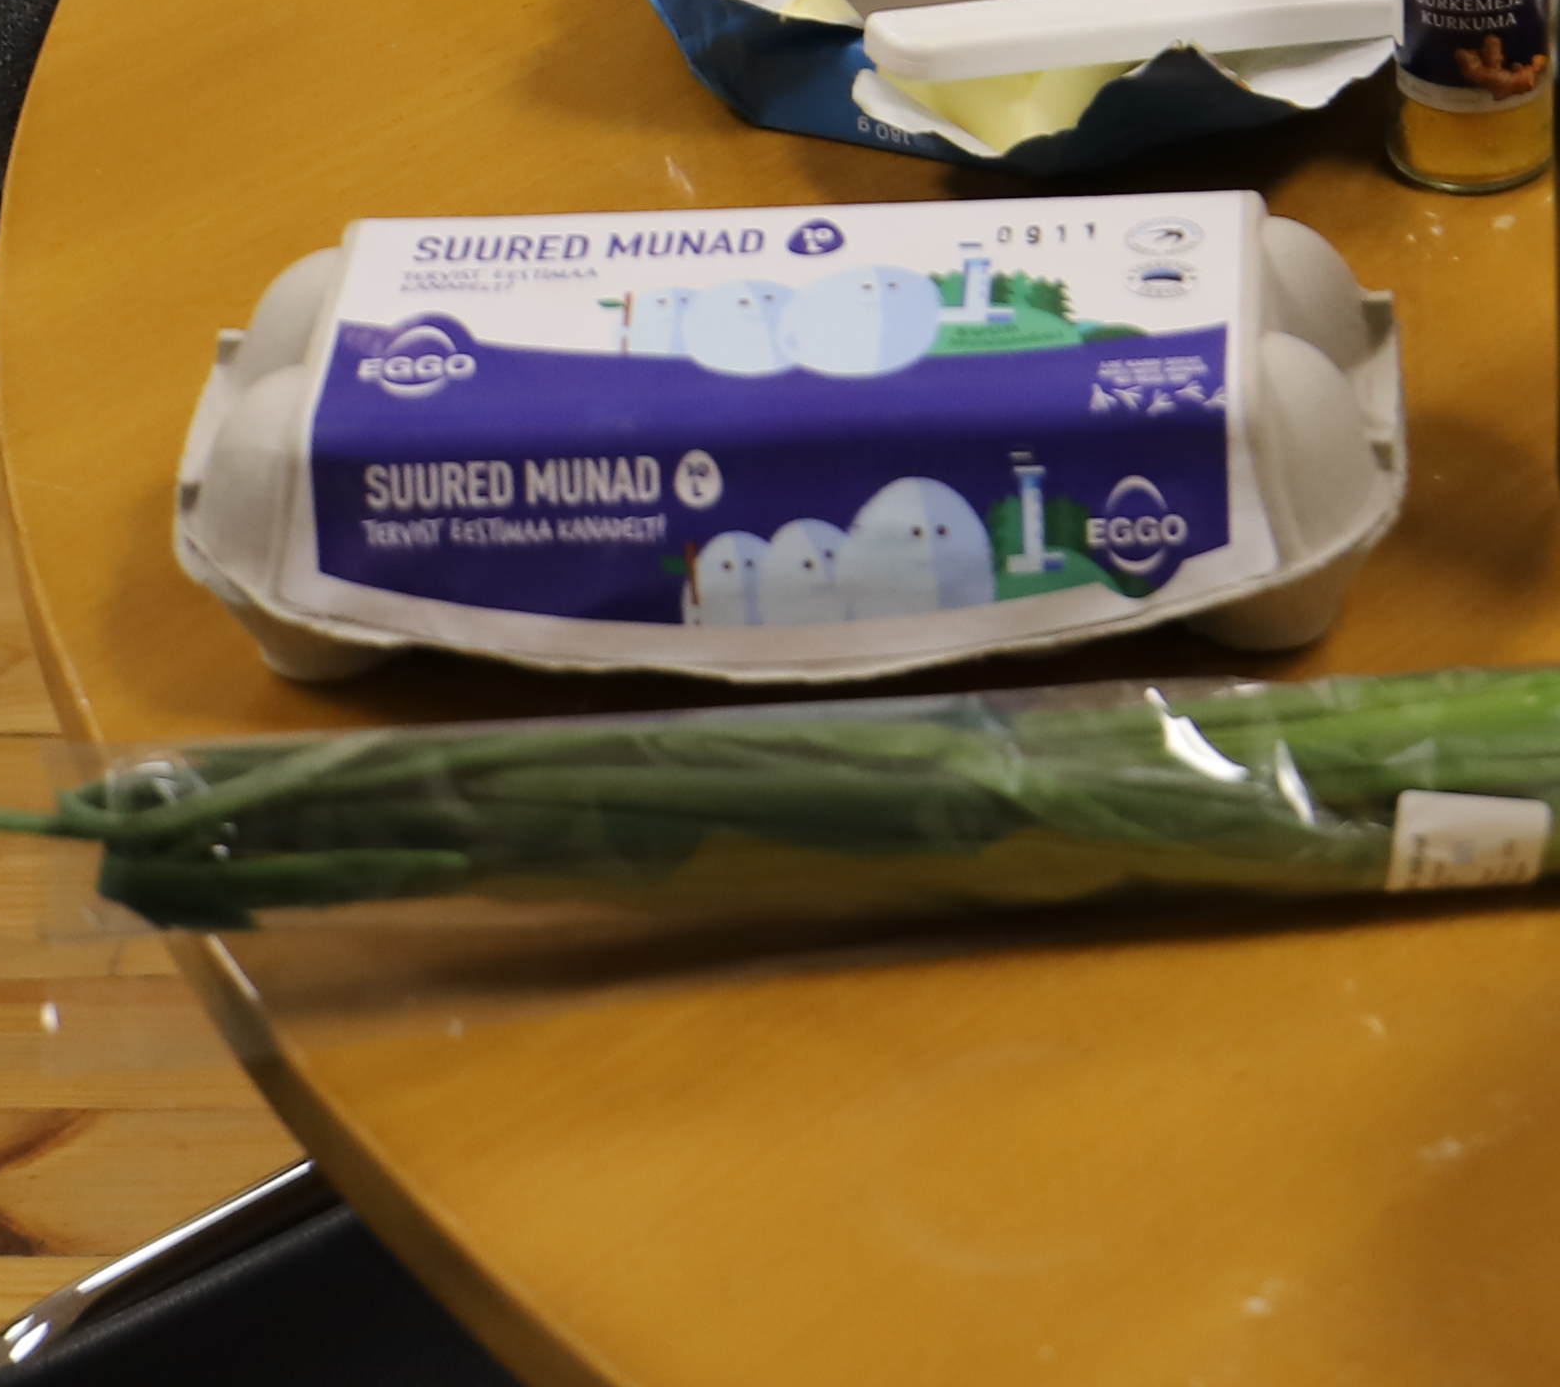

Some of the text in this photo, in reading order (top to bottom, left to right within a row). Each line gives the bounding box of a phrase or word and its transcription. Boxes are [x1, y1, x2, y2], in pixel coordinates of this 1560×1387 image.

[1420, 9, 1518, 31] KURKUMA
[413, 233, 590, 262] SUURED
[605, 227, 767, 258] MUNAD
[355, 352, 478, 382] EGGO
[363, 458, 514, 511] SUURED
[524, 454, 662, 507] MUNAD
[1084, 513, 1189, 548] EGGO
